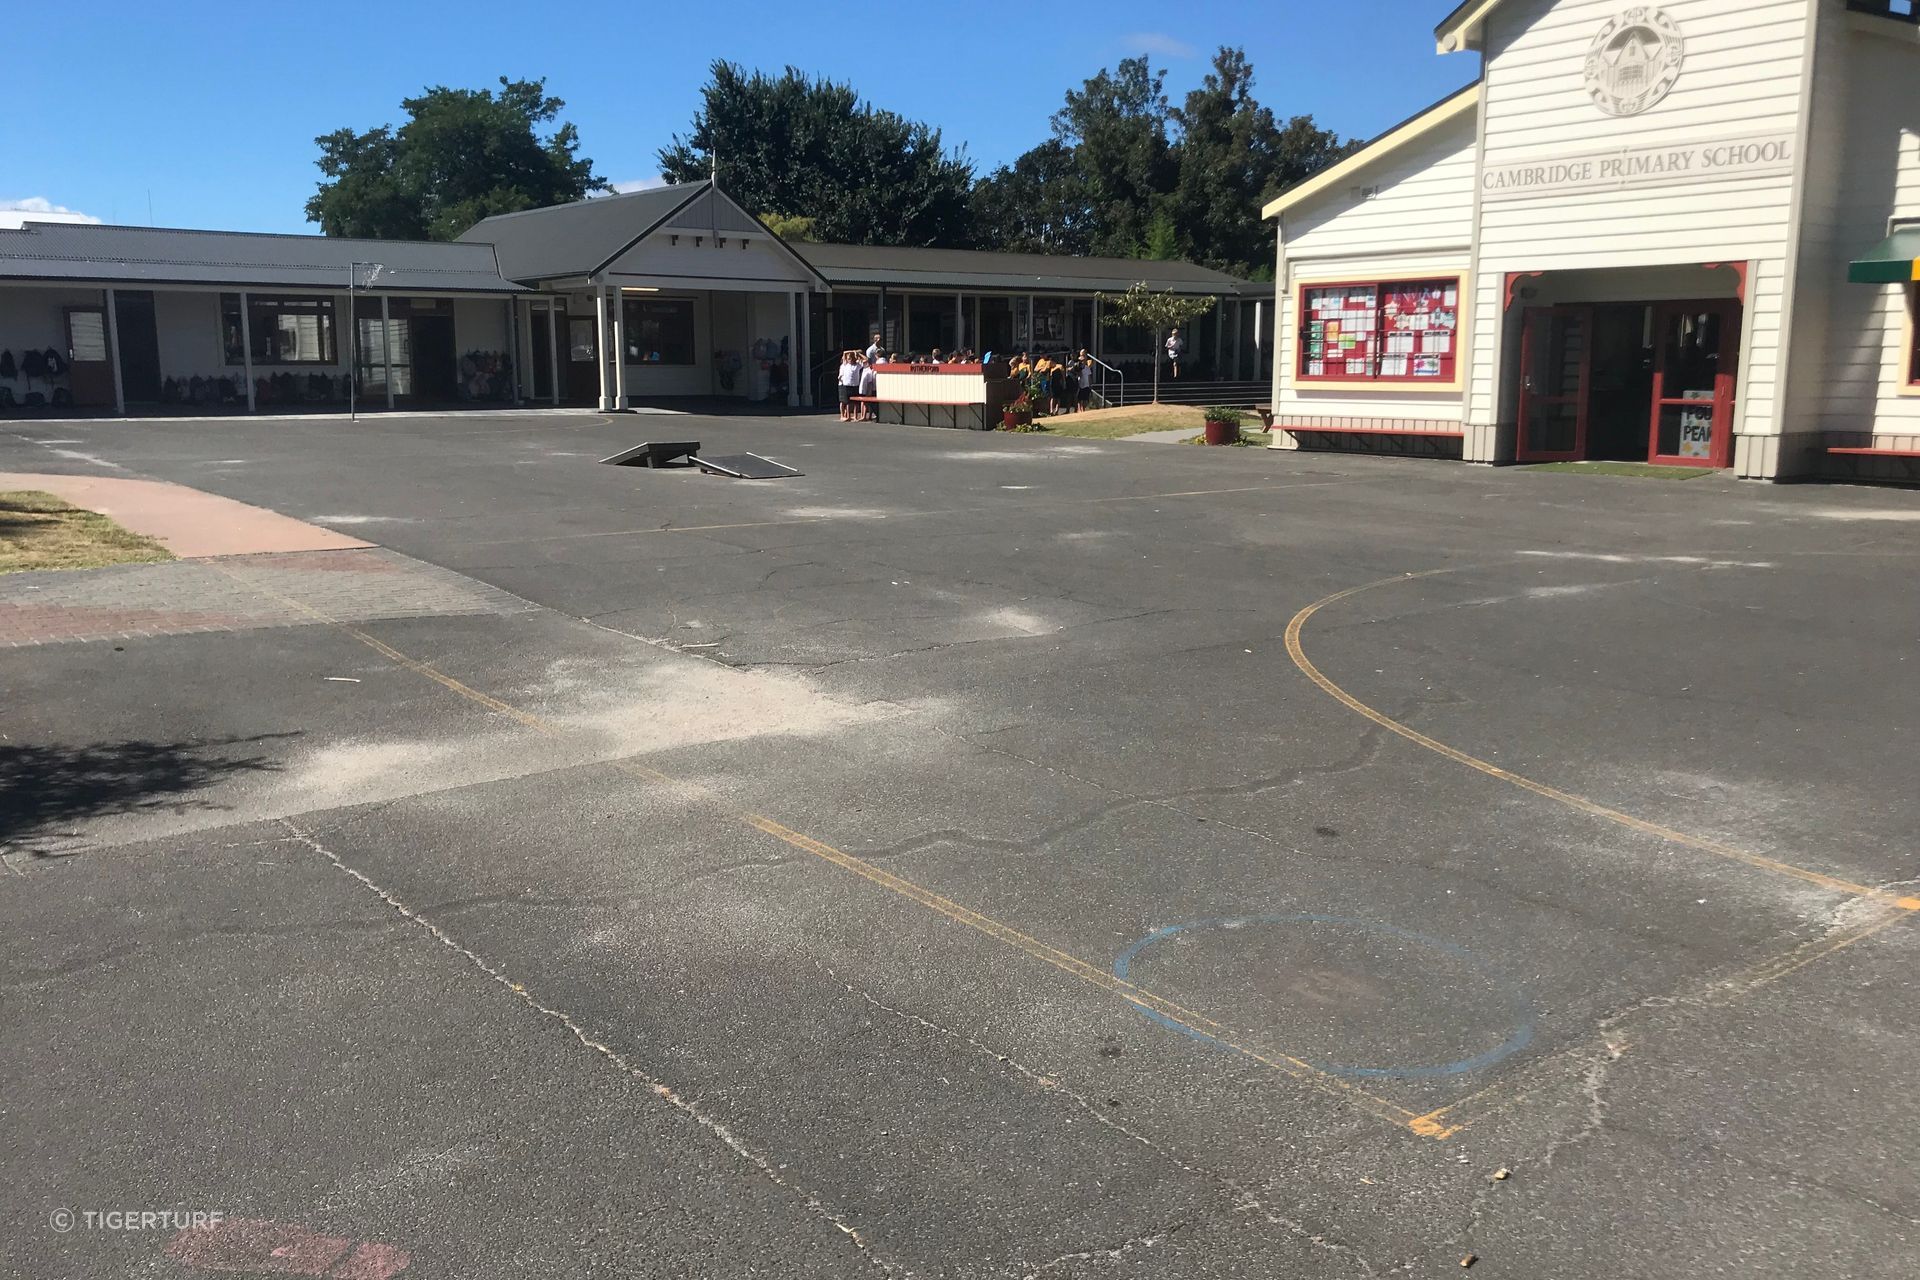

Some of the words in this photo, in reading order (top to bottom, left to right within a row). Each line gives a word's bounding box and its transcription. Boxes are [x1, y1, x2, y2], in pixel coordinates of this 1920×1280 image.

[1482, 162, 1593, 190] CAMBRIDGE
[1599, 150, 1696, 178] PRIMARY
[1700, 140, 1793, 169] SCHOOL
